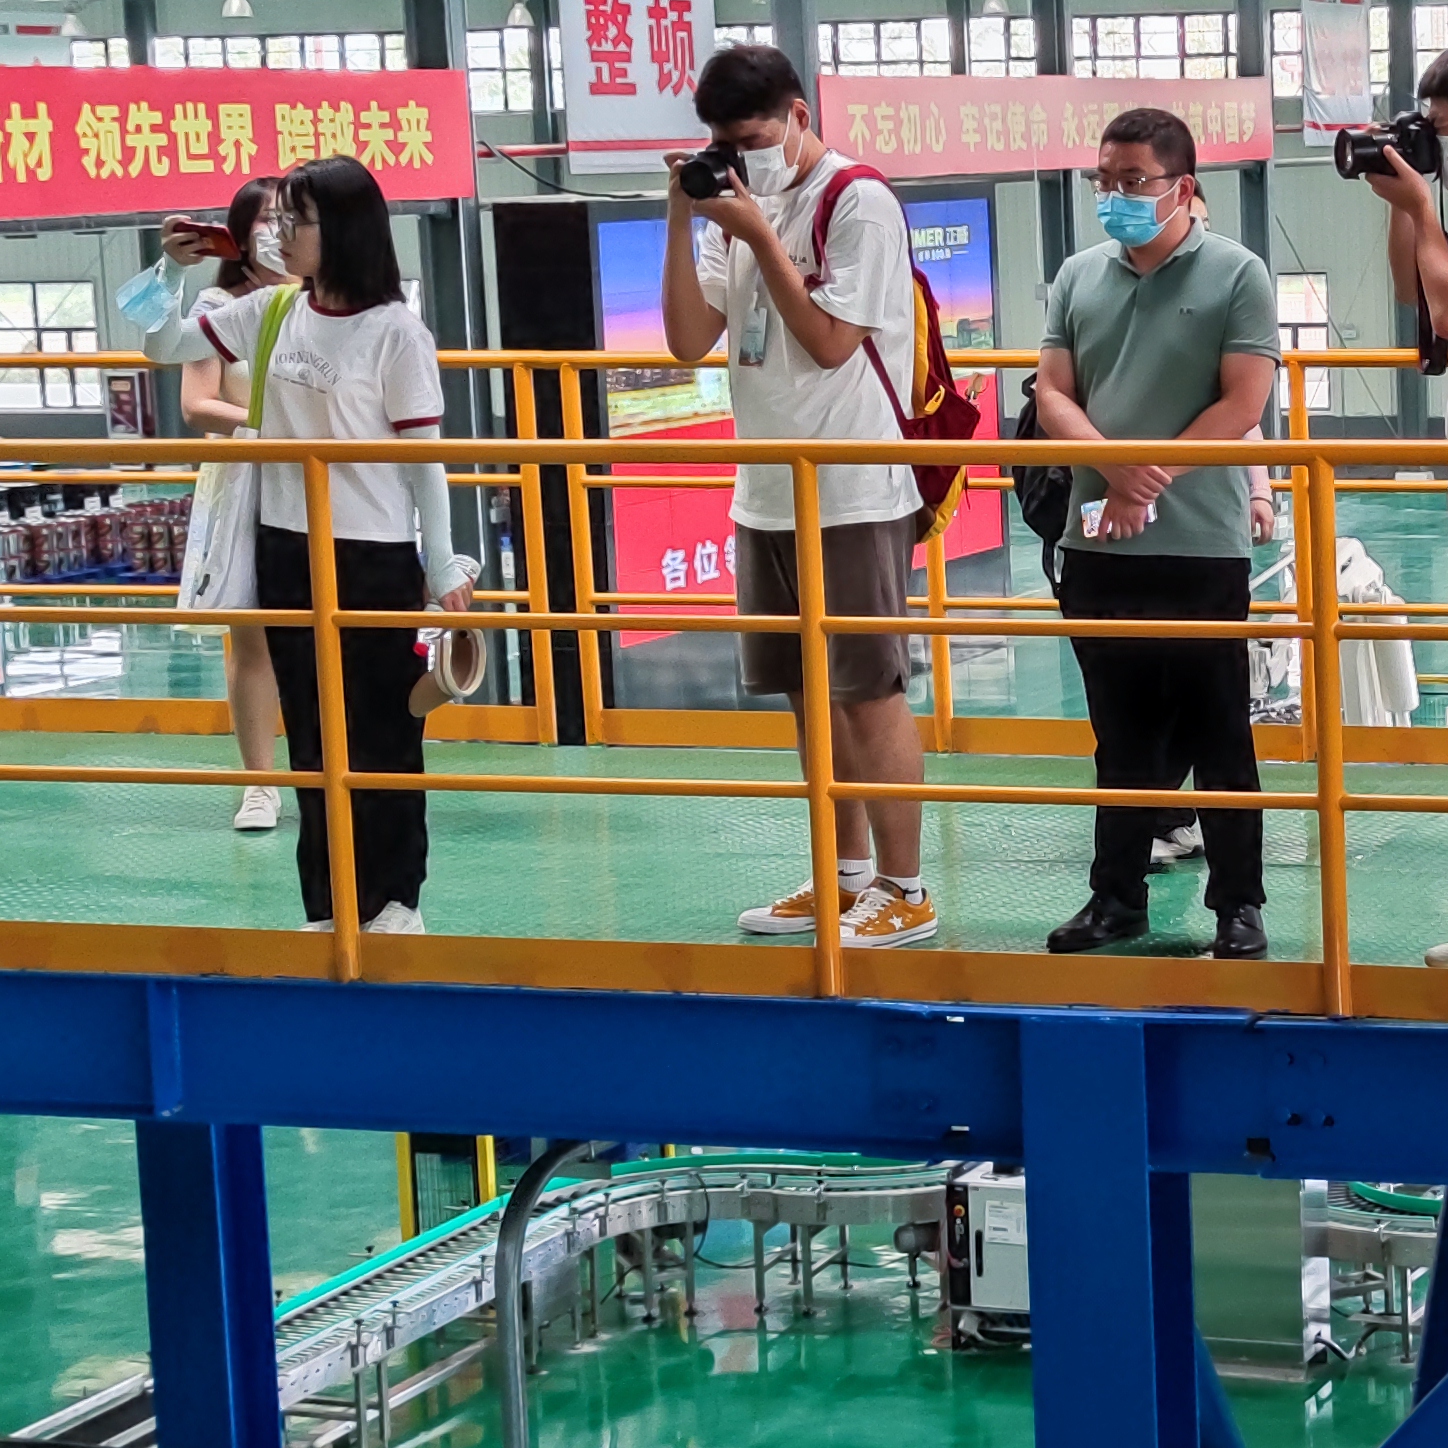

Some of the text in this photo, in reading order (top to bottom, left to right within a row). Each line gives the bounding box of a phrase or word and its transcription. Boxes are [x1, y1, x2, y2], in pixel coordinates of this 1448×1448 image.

[76, 100, 258, 179] 领先世界
[275, 99, 434, 171] 跨越未来
[847, 100, 948, 156] 不忘初心
[959, 100, 1049, 152] 牢记使命
